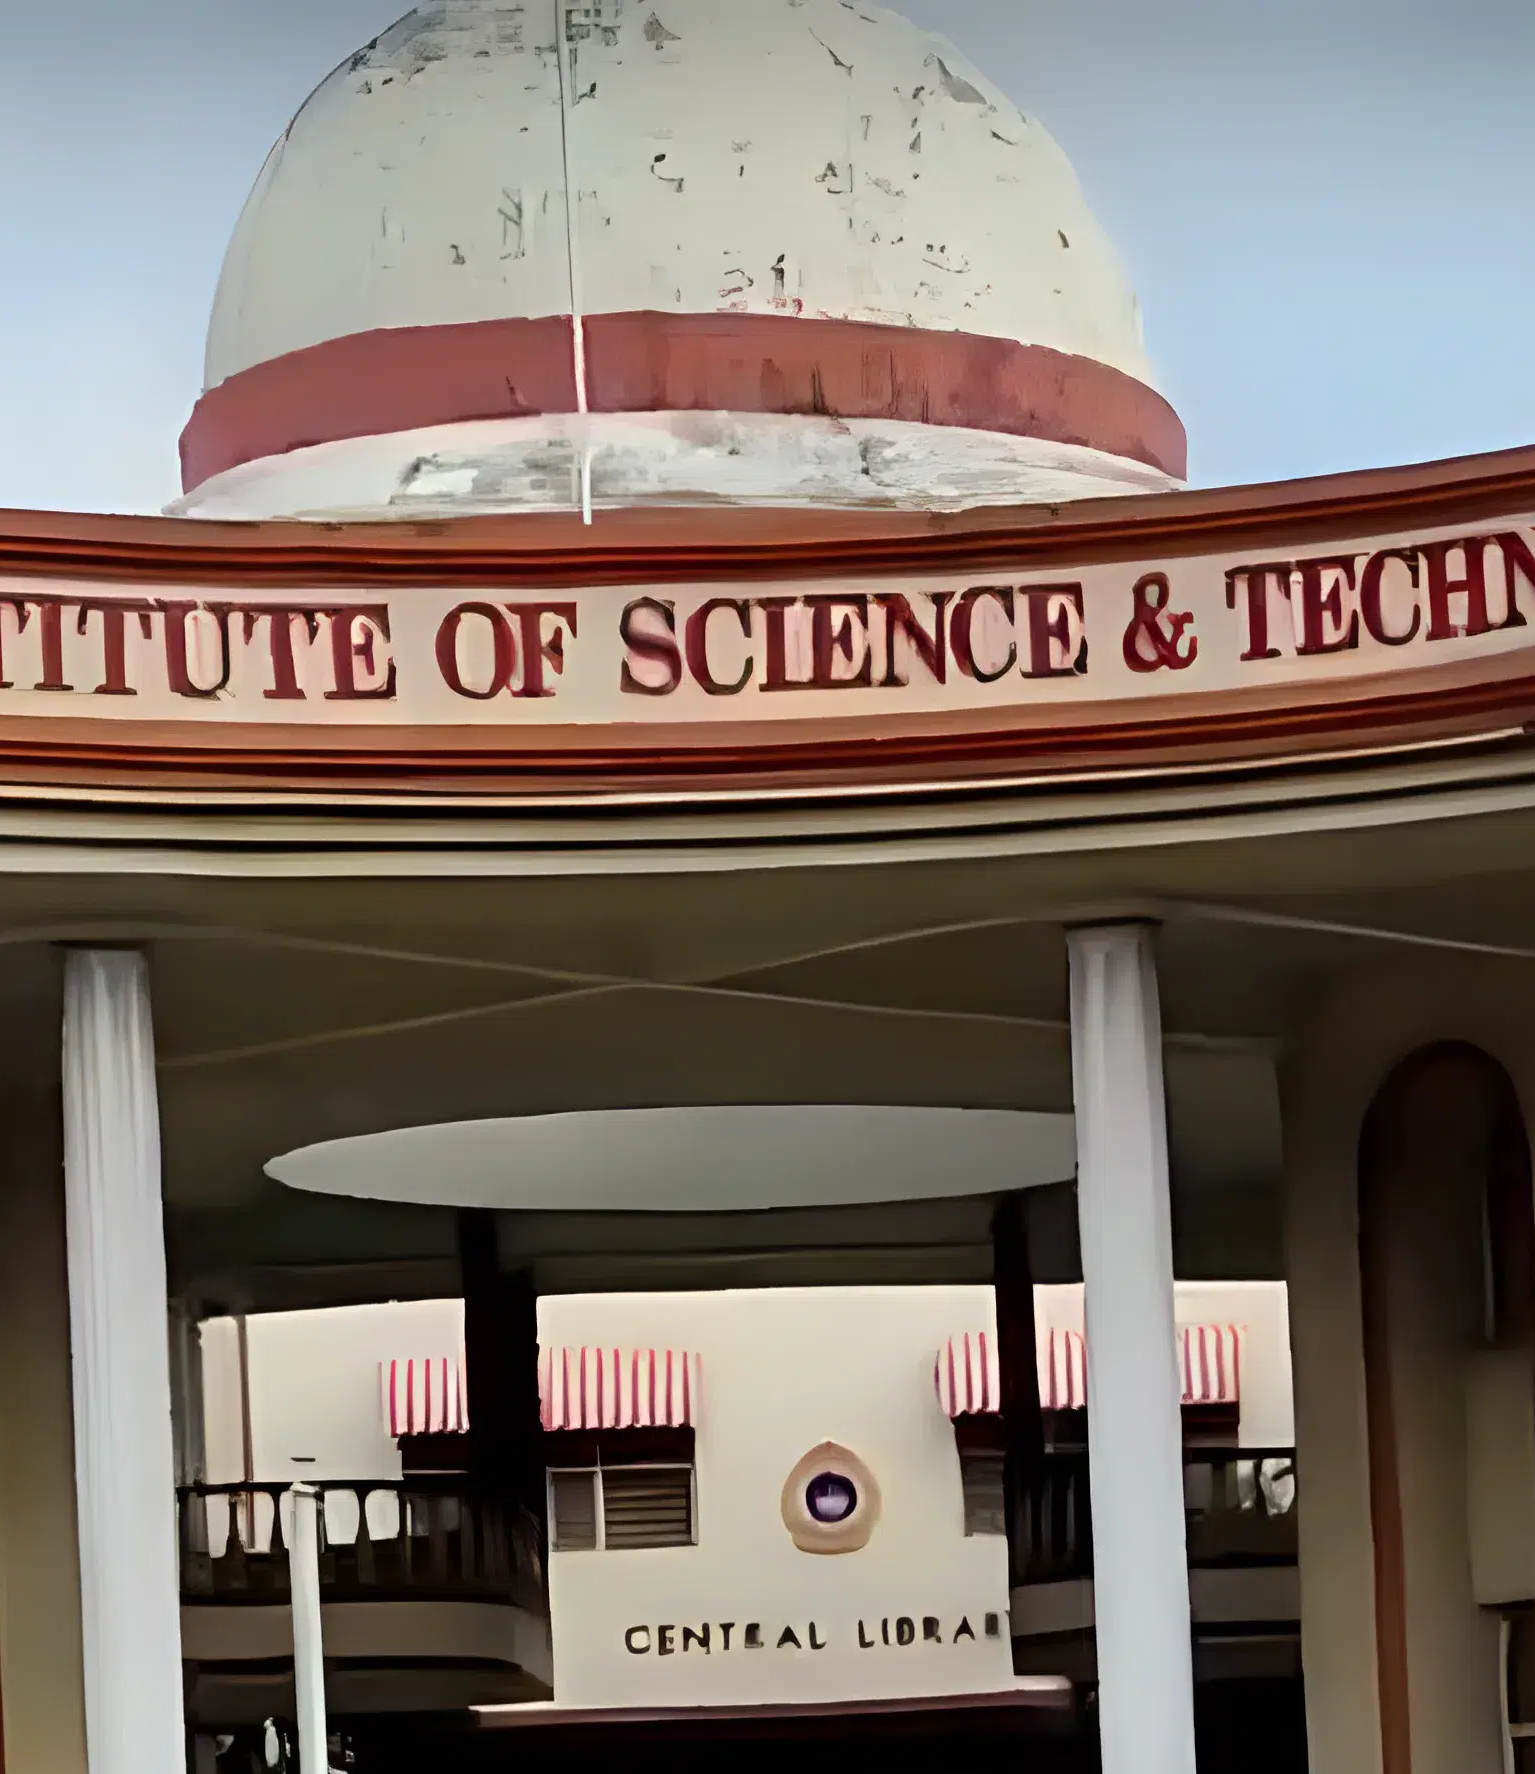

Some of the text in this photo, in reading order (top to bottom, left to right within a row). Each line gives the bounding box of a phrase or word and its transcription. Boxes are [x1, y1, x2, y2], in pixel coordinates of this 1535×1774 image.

[435, 600, 579, 700] OF
[618, 580, 1091, 697] SCIENCE
[1122, 570, 1200, 673] &
[624, 1610, 1010, 1656] CENTRAL LIBRAR
